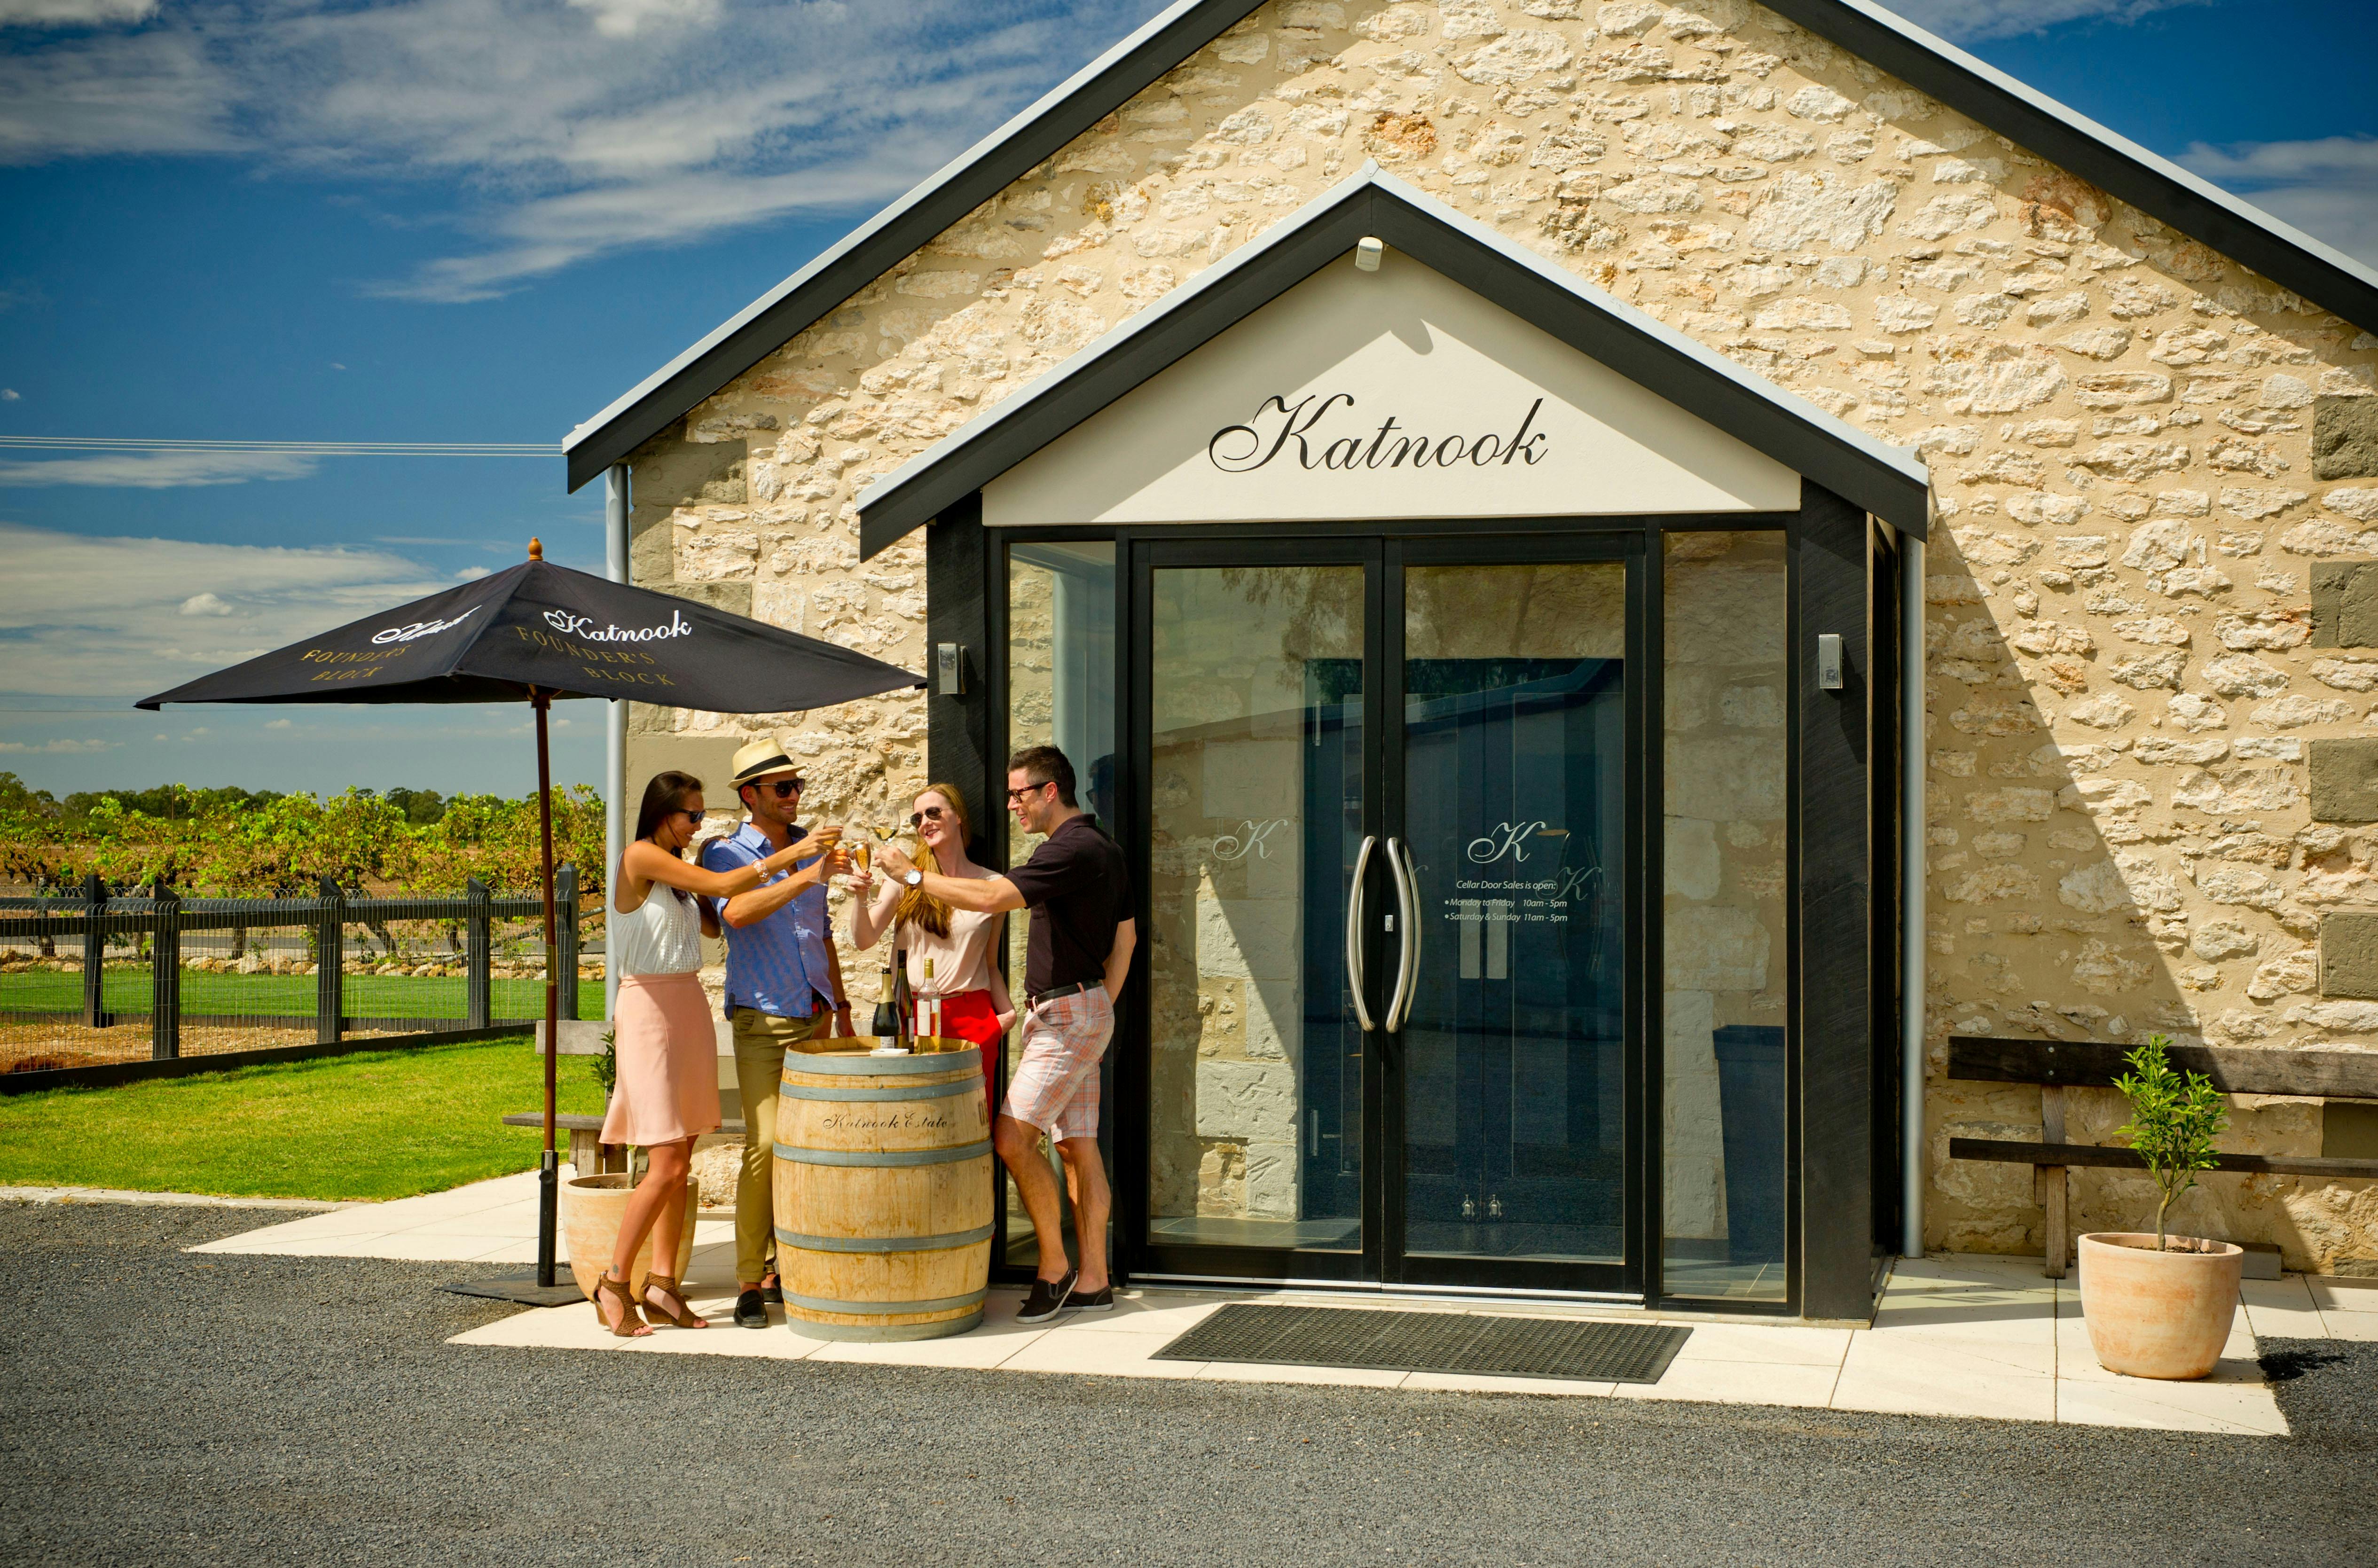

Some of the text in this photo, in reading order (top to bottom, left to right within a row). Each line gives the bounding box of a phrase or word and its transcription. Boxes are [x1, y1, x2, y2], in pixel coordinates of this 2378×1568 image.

[1209, 394, 1548, 472] Katnook
[543, 610, 692, 642] Katnook
[301, 645, 411, 663] FOUNDER'S
[515, 626, 655, 664] FOUNDER'S
[310, 666, 384, 681] BLOCK
[582, 666, 676, 685] BLOCK
[1213, 819, 1288, 861] K
[1467, 821, 1546, 864] K
[1456, 880, 1556, 891] Cellar Door Sales is open:
[1450, 898, 1481, 908] Monday
[1491, 899, 1515, 908] Friday
[1550, 899, 1568, 909] 5pm
[1450, 912, 1484, 922] Saturday
[1491, 913, 1521, 922] Sunday
[1550, 914, 1568, 923] 5pm
[823, 1112, 947, 1129] Katnook Estate
